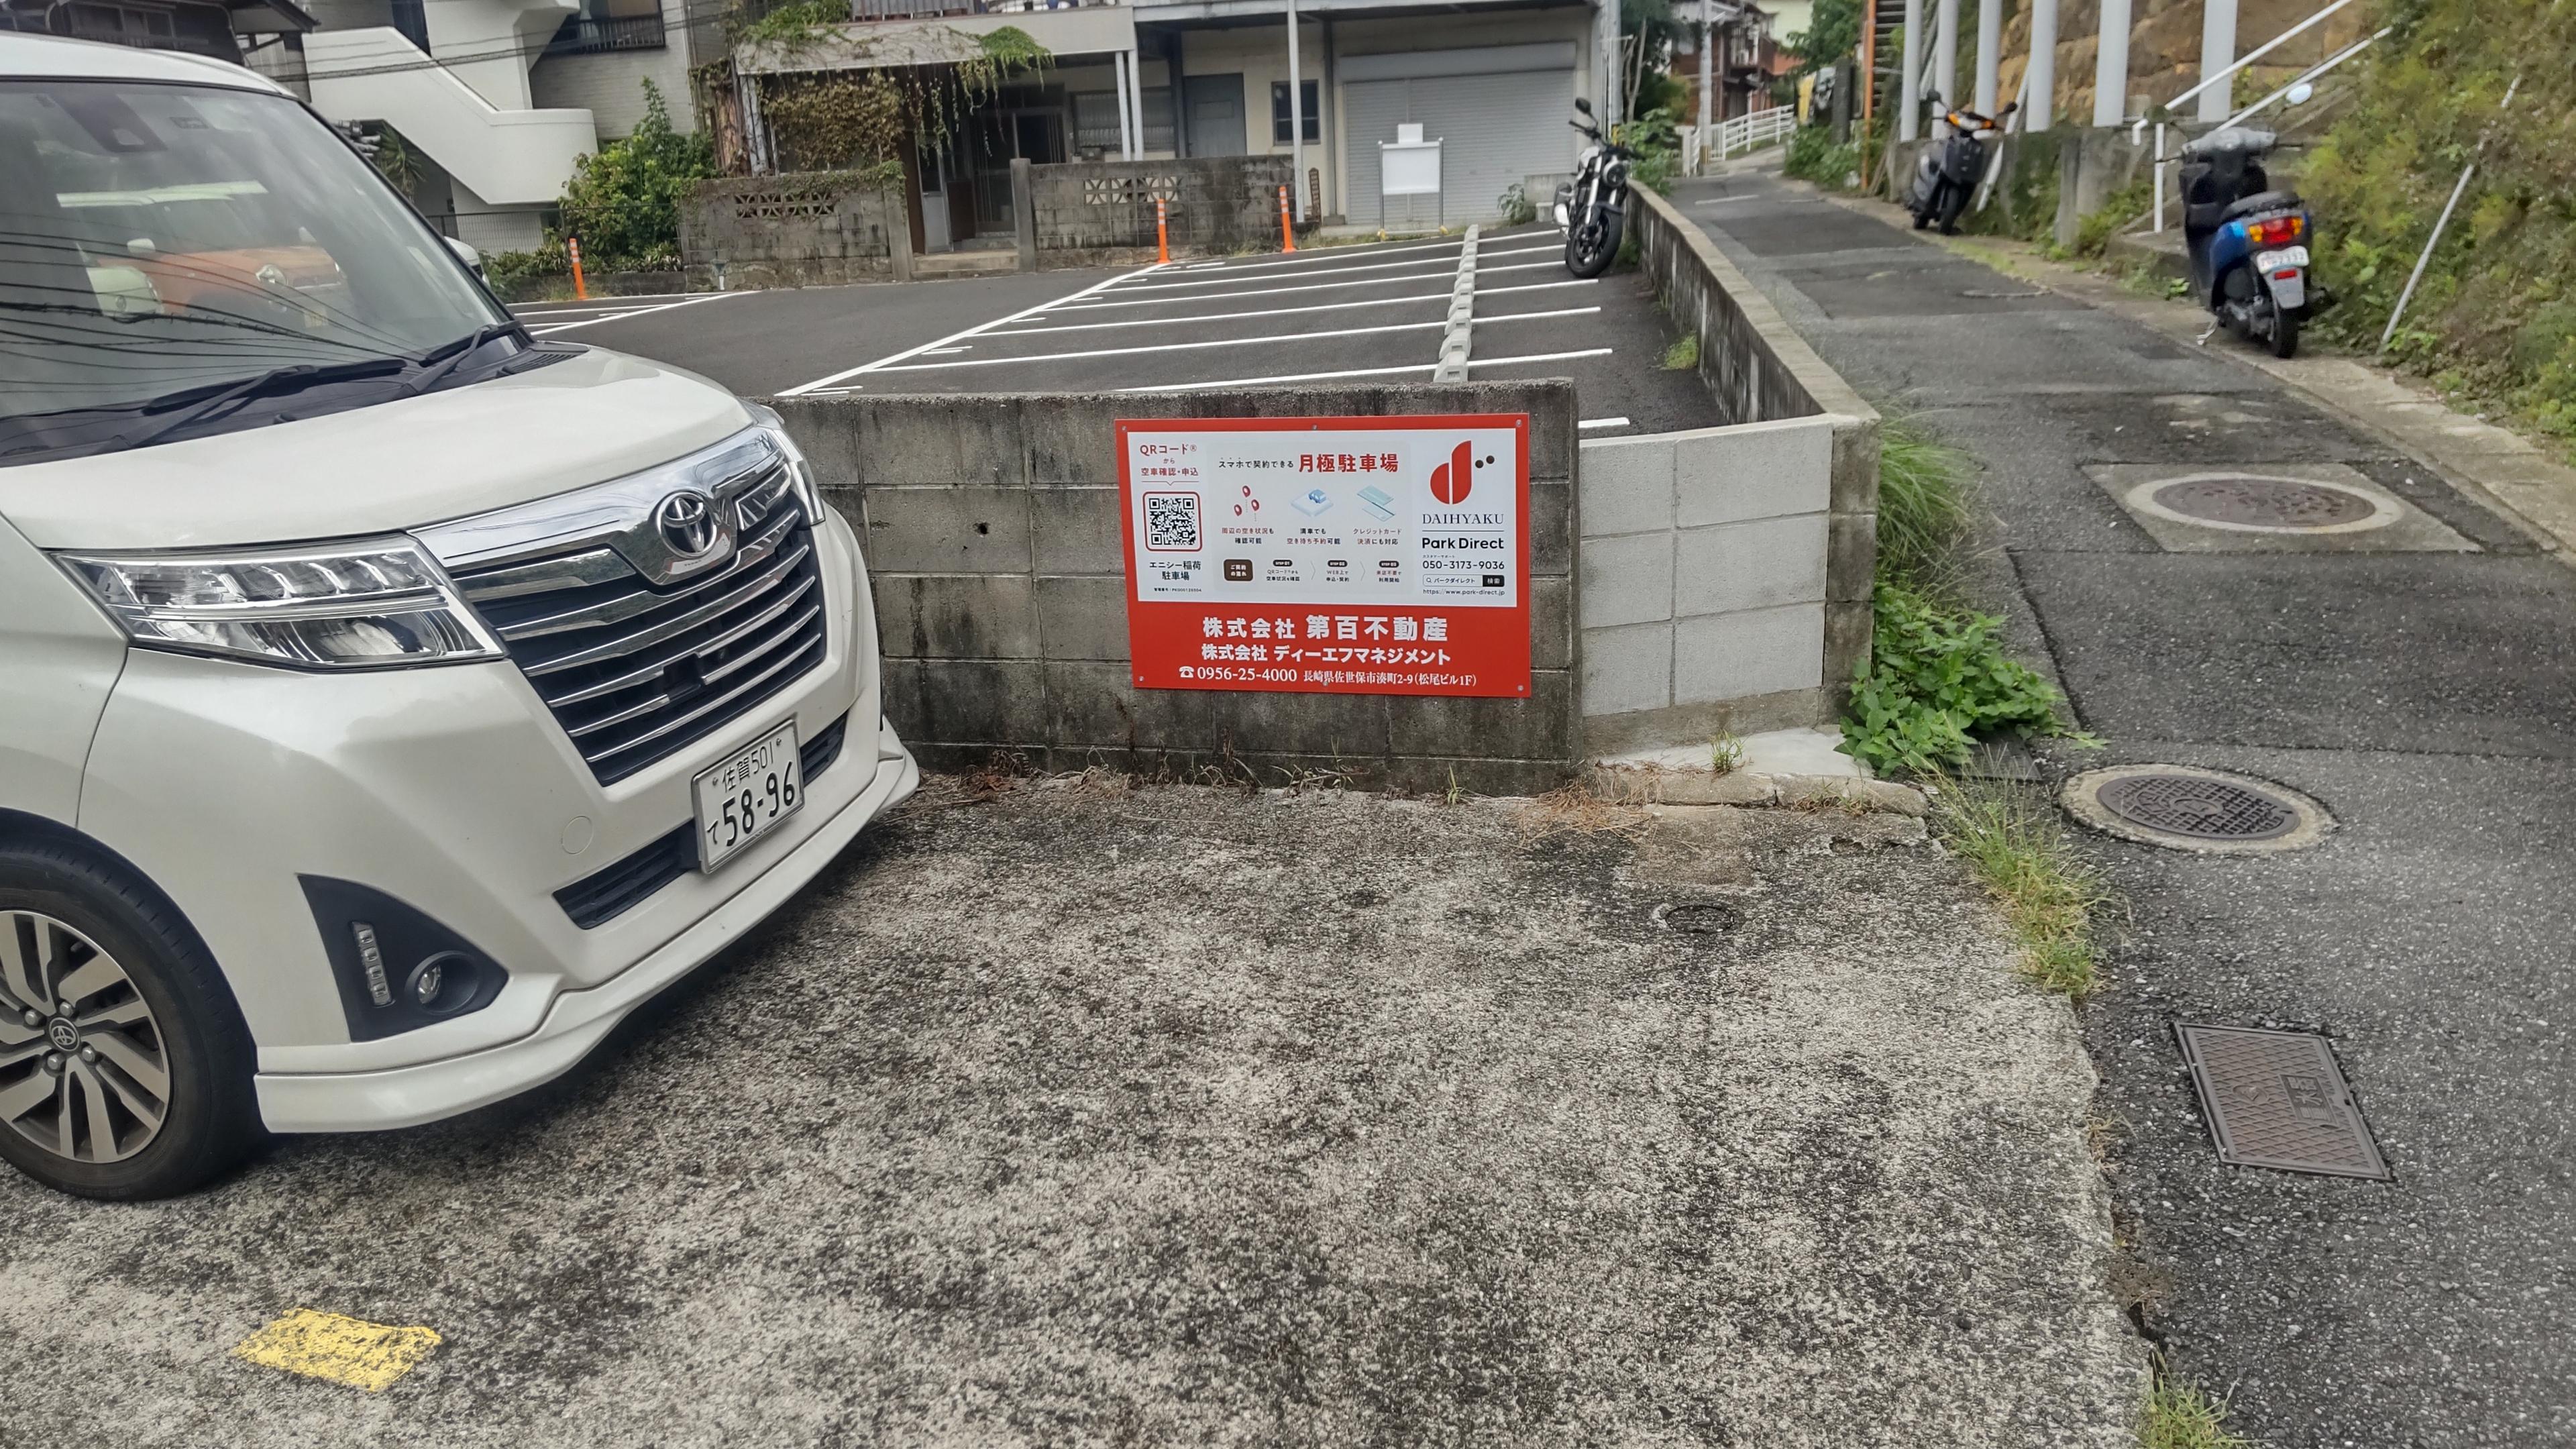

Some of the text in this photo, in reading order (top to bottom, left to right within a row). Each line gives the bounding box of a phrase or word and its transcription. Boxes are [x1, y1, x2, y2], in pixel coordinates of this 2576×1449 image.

[1218, 453, 1399, 473] スマホで契約できる 月極駐車場
[1422, 513, 1504, 524] DAIHYAKU
[1422, 537, 1505, 549] Park Direct
[1149, 561, 1201, 570] エニシー稲荷
[1422, 560, 1505, 570] 050-3173-9036
[1162, 572, 1189, 581] 駐車場
[1422, 588, 1505, 596] https://www.park-direct.jp
[1203, 614, 1448, 641] 株式会社 第百不動産
[1201, 643, 1450, 665] 株式会社 ディーエフマネジメント
[1197, 666, 1297, 682] 0956-25-4000
[722, 761, 795, 847] 58-96
